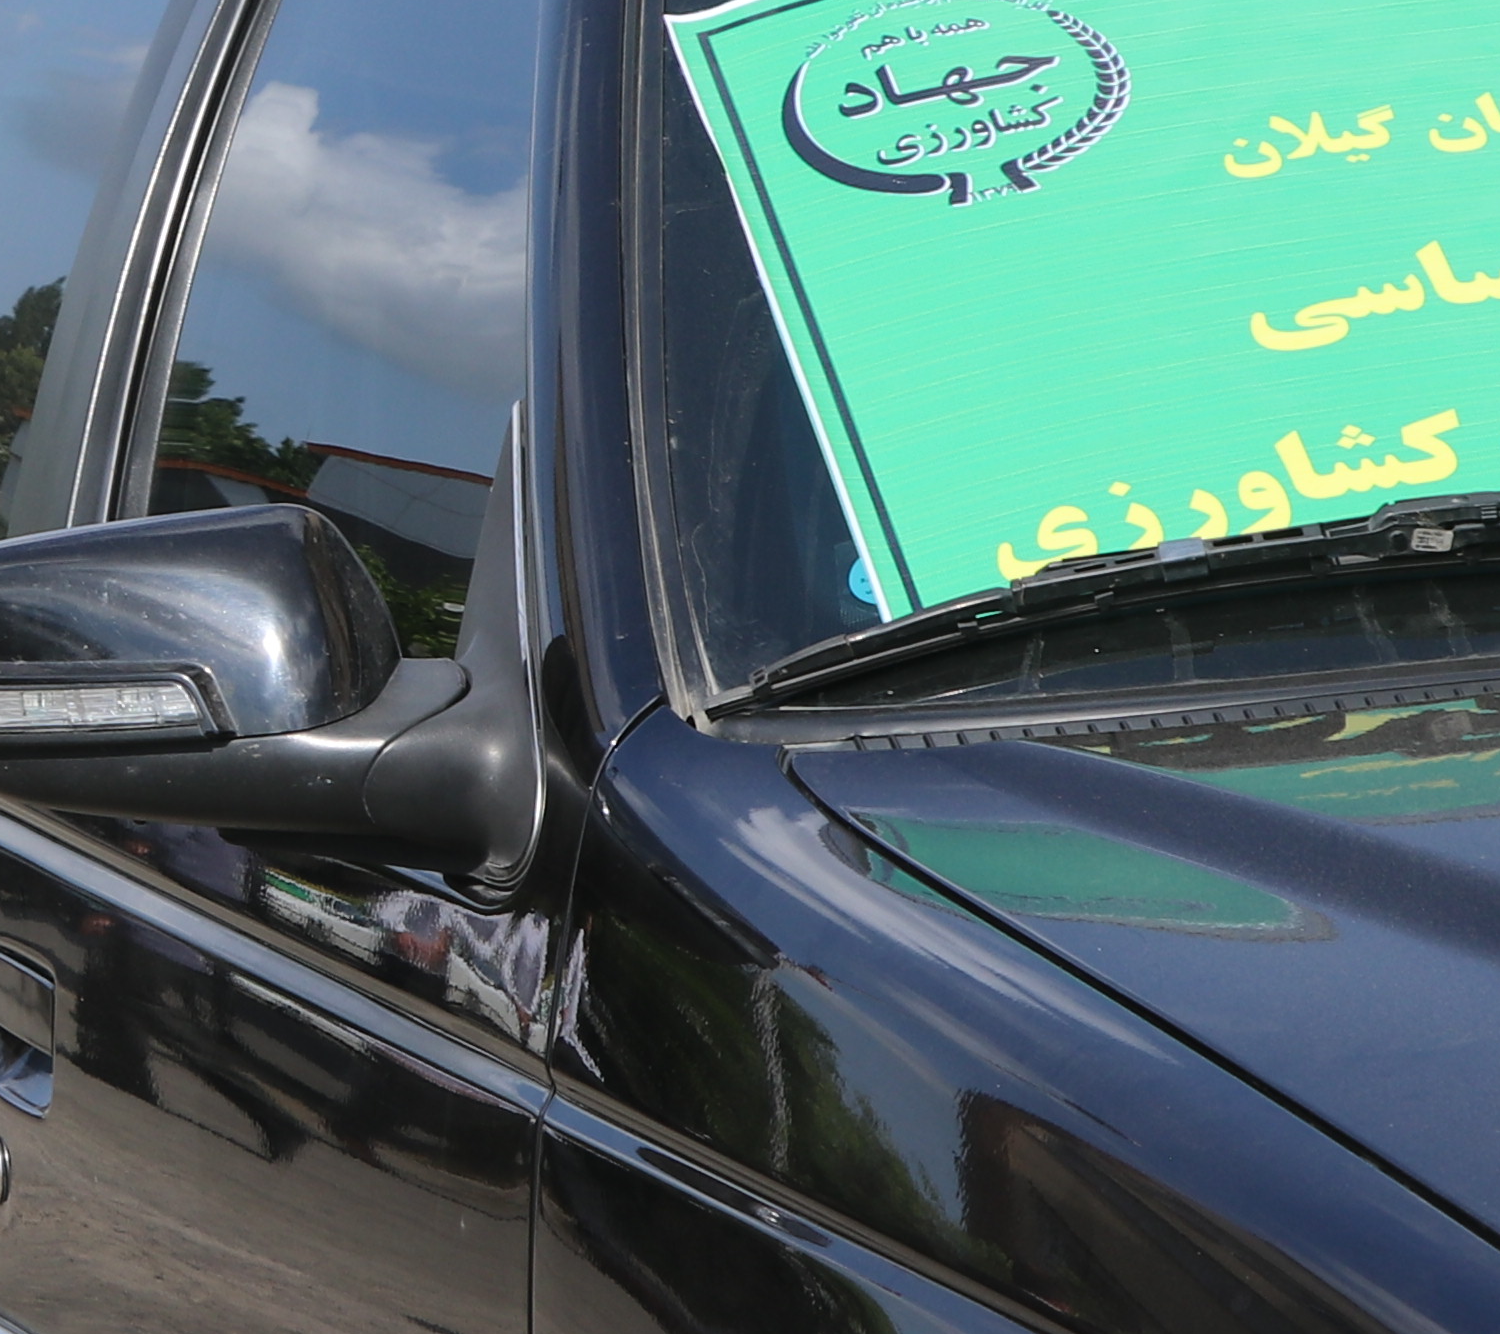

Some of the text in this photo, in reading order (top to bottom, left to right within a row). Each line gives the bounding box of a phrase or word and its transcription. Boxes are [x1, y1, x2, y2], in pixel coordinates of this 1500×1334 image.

[860, 16, 991, 61] همه با هم
[839, 54, 1059, 118] جهاد
[876, 95, 1063, 167] کشاورزی
[1224, 105, 1394, 178] گیلان
[999, 409, 1460, 581] کشاورزی
